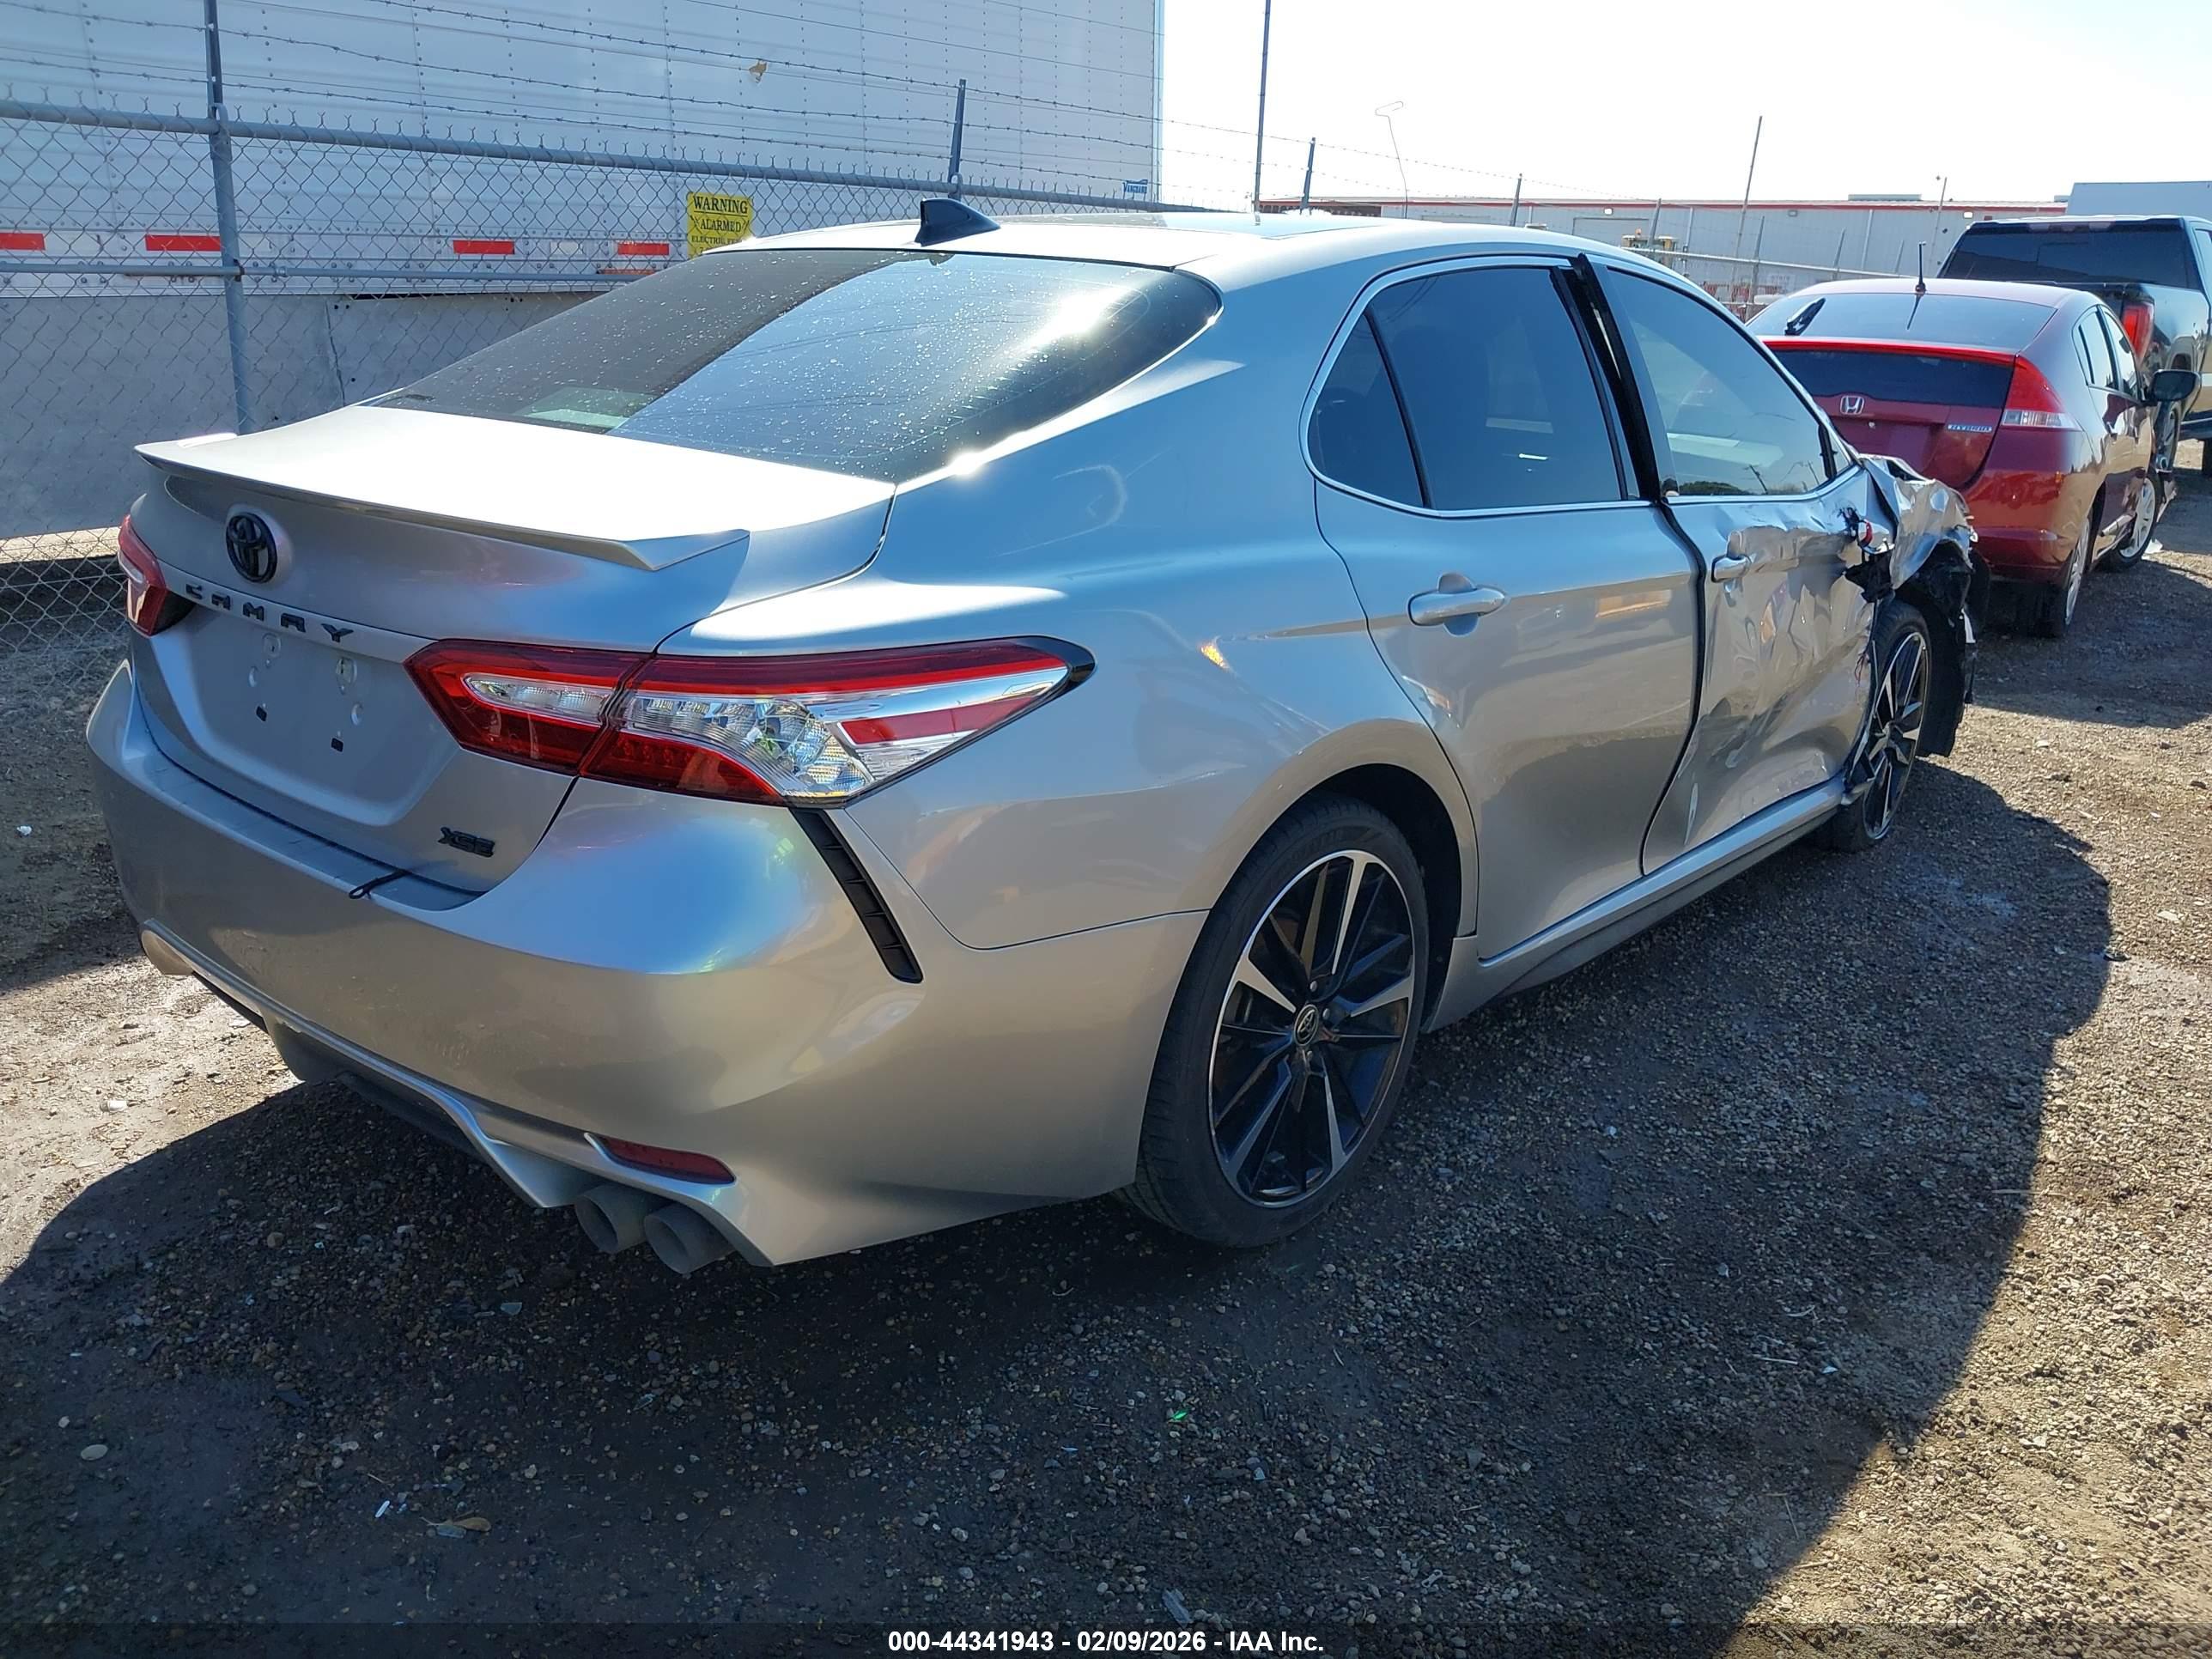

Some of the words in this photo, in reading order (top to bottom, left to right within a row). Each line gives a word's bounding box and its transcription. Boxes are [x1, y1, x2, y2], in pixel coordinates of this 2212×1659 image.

[693, 196, 748, 214] WARNING
[700, 219, 742, 233] ALARMED
[185, 583, 354, 643] CAMRY
[438, 827, 495, 858] XSE
